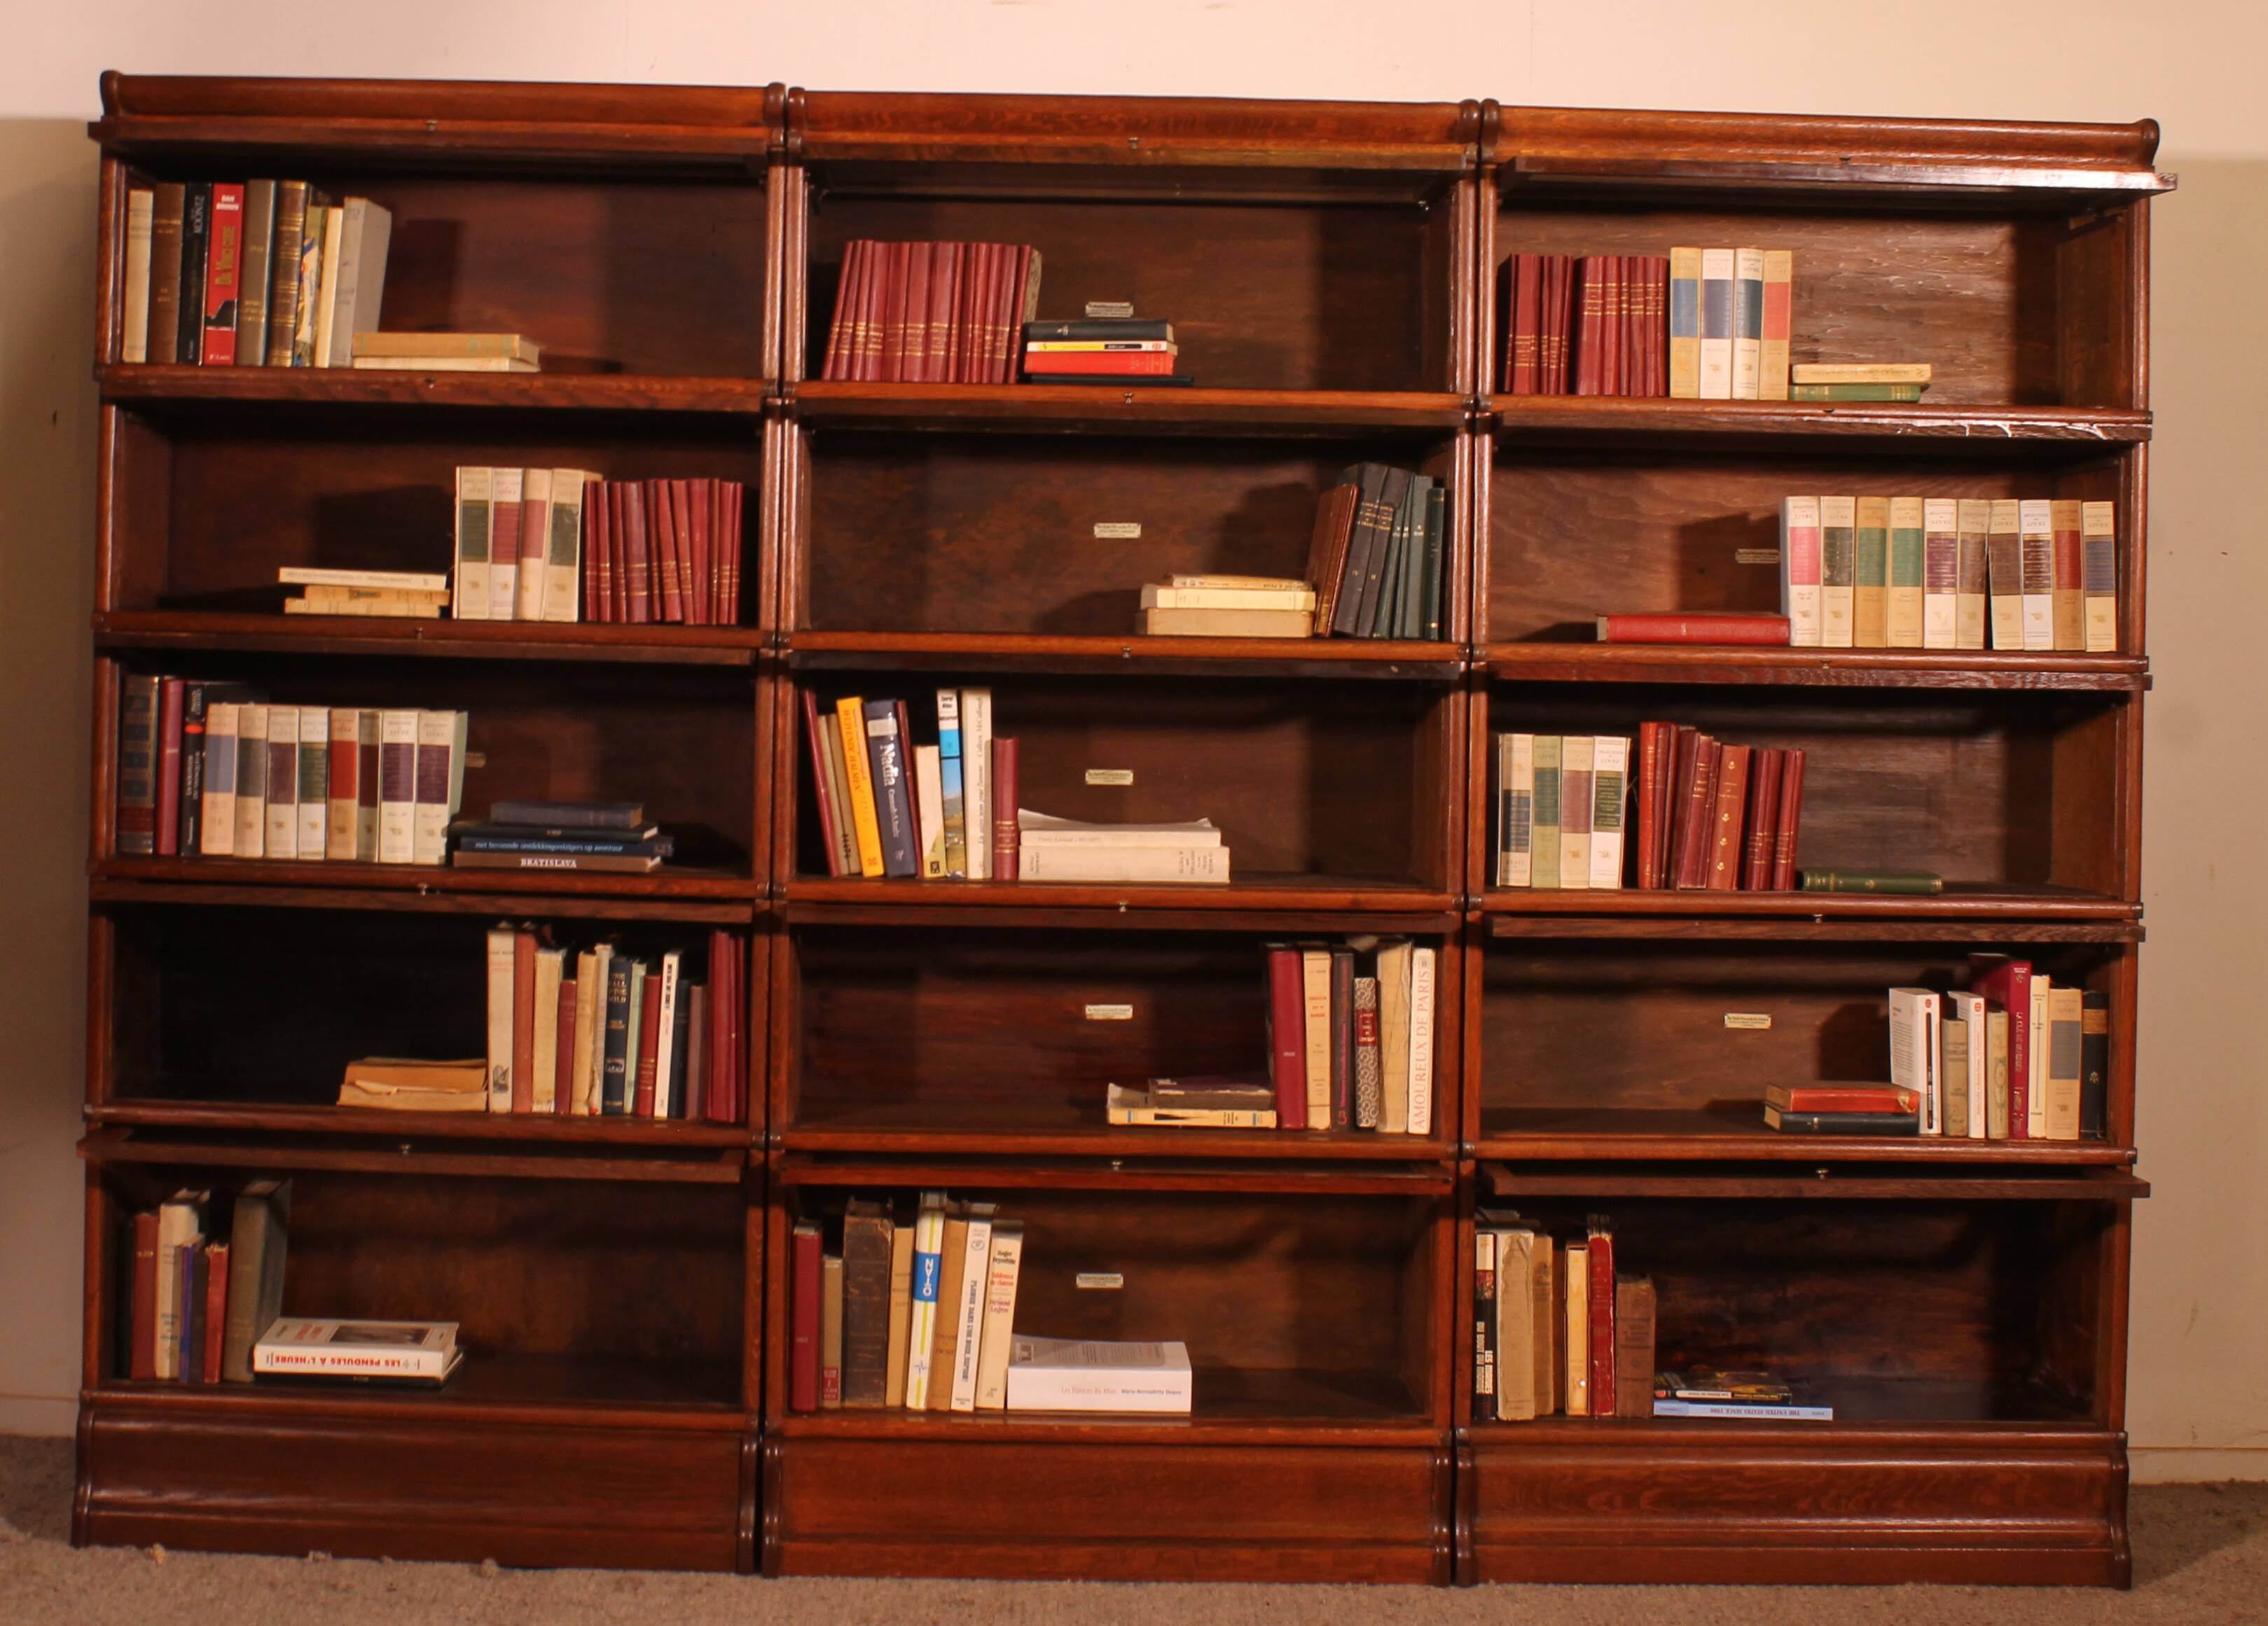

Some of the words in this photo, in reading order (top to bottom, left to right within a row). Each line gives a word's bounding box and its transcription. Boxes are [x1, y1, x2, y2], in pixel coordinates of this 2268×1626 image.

[216, 202, 240, 211] BROWN
[193, 195, 205, 234] KOONTZ
[880, 743, 899, 786] Nadia
[520, 857, 577, 869] BRATISLAVA
[1417, 970, 1430, 1012] PARIS
[1416, 1019, 1428, 1037] DE
[1414, 1041, 1427, 1129] AMOUREUX
[274, 1356, 316, 1365] L'HEURE
[319, 1357, 327, 1366] À
[331, 1358, 381, 1367] PENDULES
[385, 1359, 401, 1367] LES
[1484, 1351, 1493, 1363] LES
